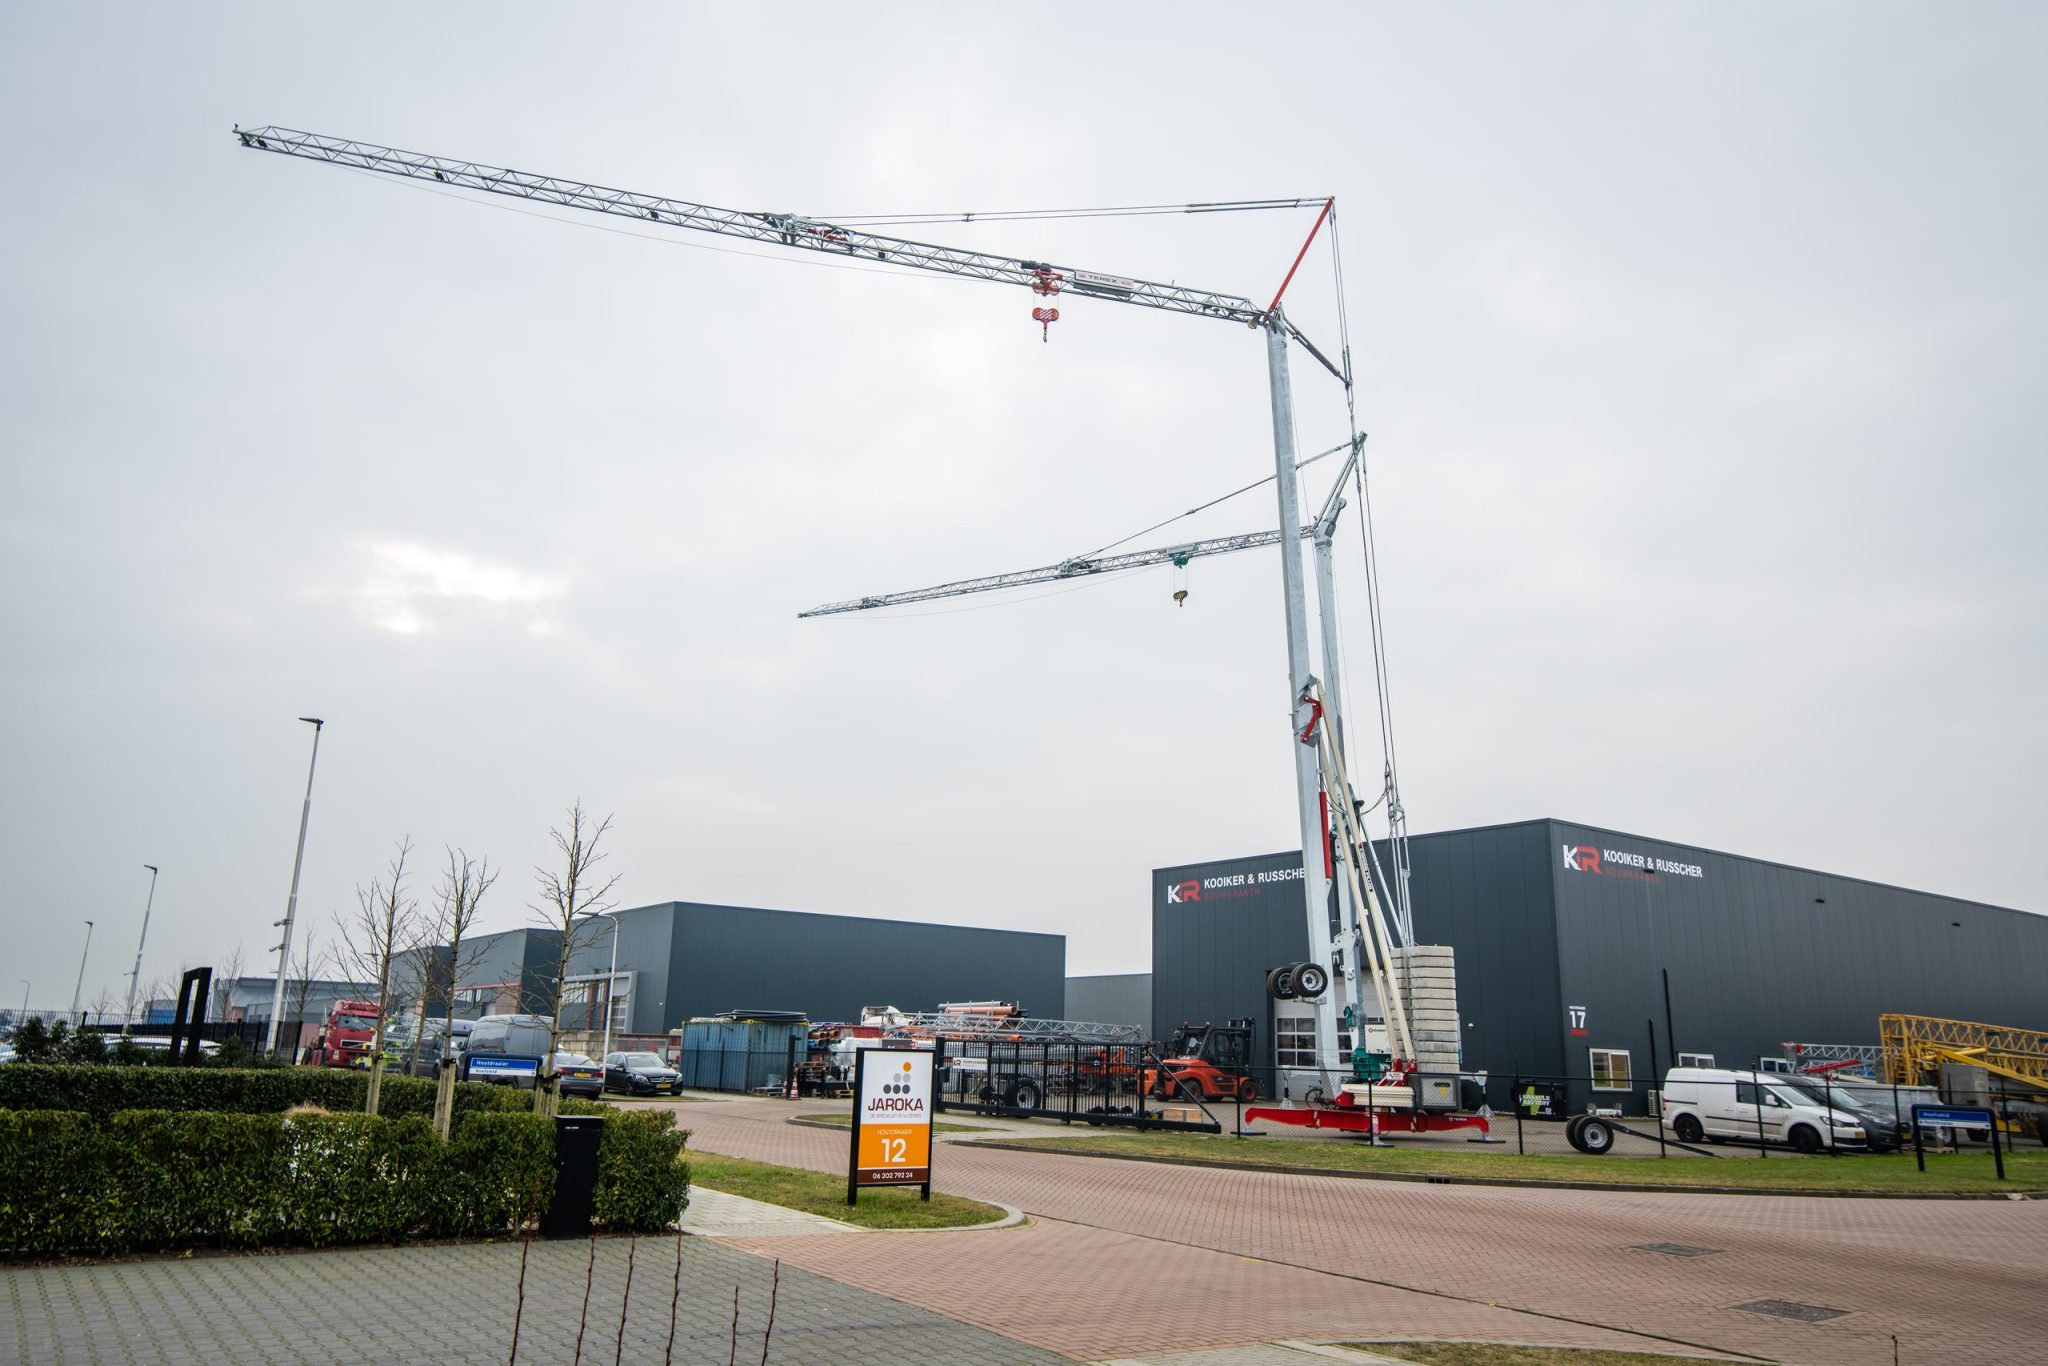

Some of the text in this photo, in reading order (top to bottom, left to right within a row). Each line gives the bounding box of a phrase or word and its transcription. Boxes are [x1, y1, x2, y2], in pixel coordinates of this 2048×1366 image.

[1563, 844, 1601, 874] KR
[1603, 849, 1645, 868] KOOIKER
[1647, 857, 1654, 869] &
[1656, 858, 1703, 878] RUSSCHER
[1204, 867, 1305, 889] KOOIKER & RUSSCHE
[1168, 880, 1201, 903] KR
[1570, 1011, 1586, 1028] 17
[867, 1098, 923, 1111] JAROKA
[881, 1138, 907, 1163] 12
